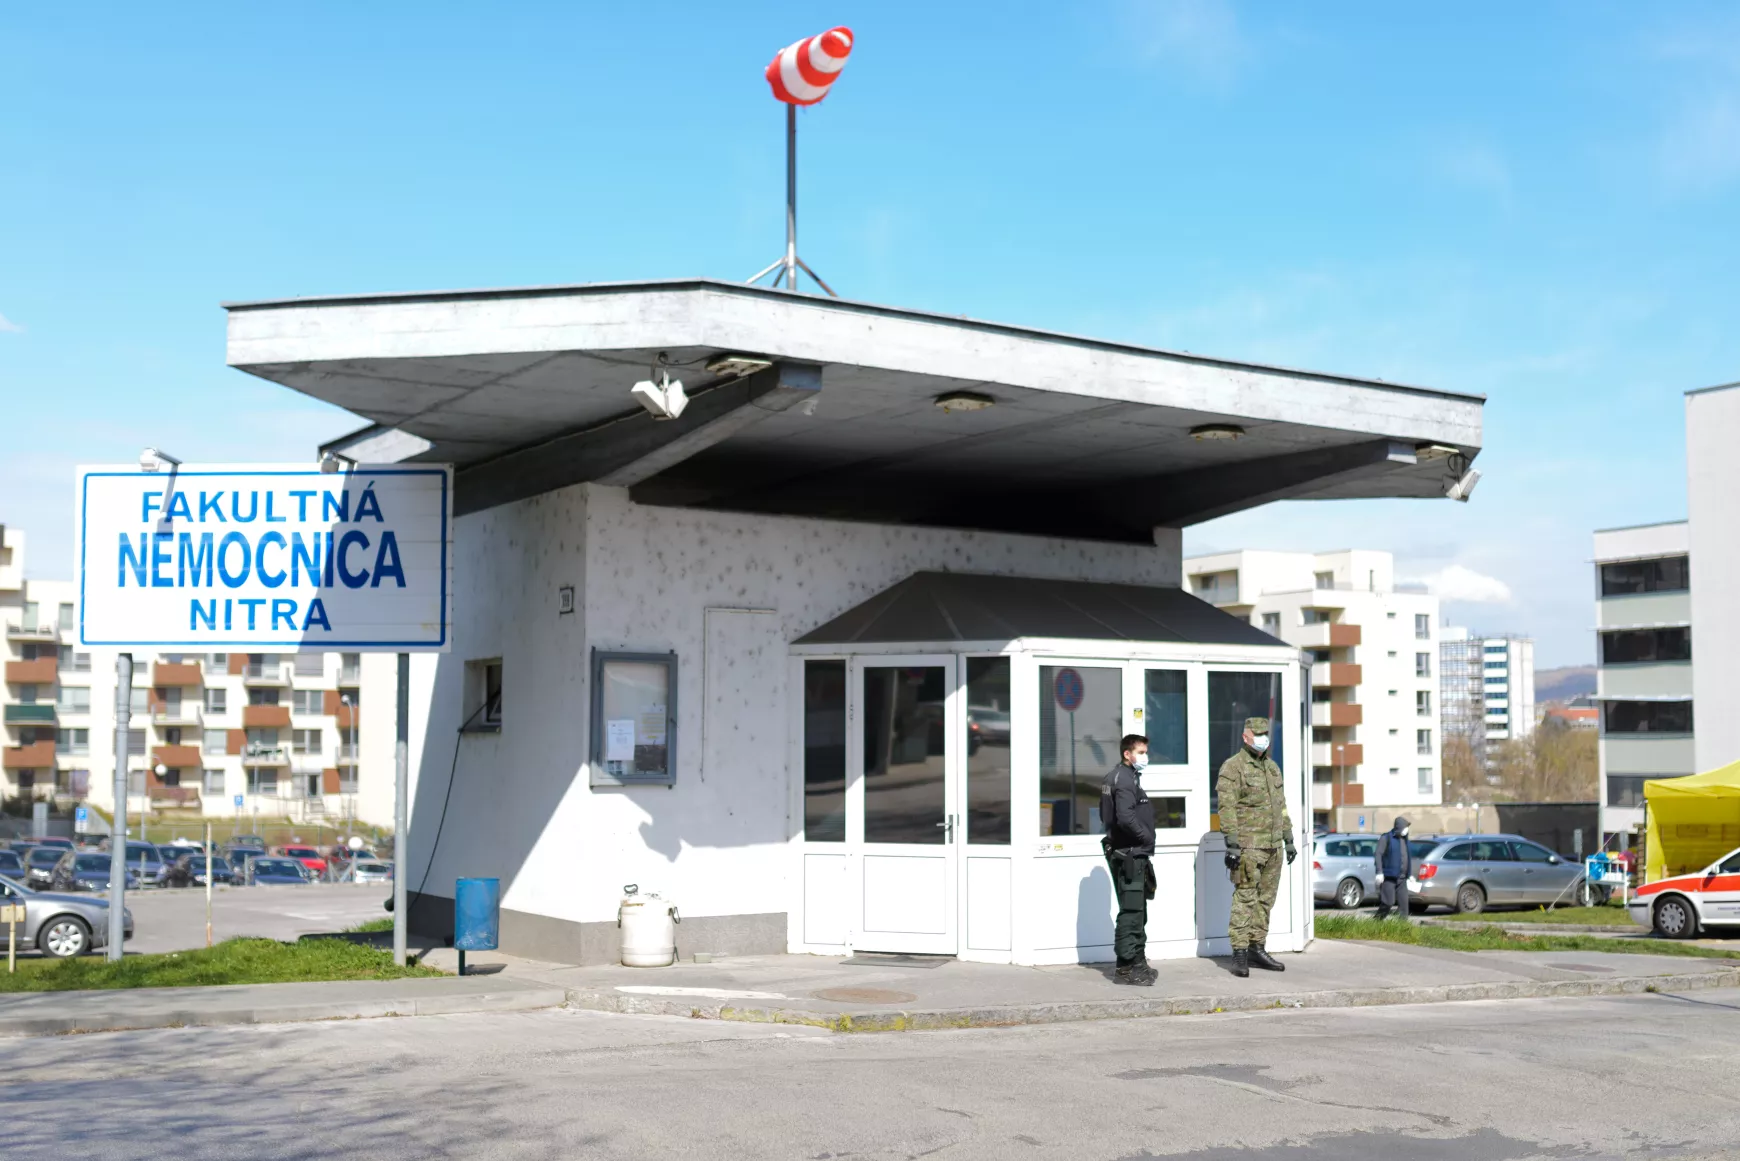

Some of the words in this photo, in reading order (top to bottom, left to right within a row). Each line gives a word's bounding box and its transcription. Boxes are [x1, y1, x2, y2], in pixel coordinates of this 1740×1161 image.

[142, 481, 384, 522] FAKULTNÁ
[118, 531, 406, 588] NEMOCNICA
[190, 599, 332, 631] NITRA
